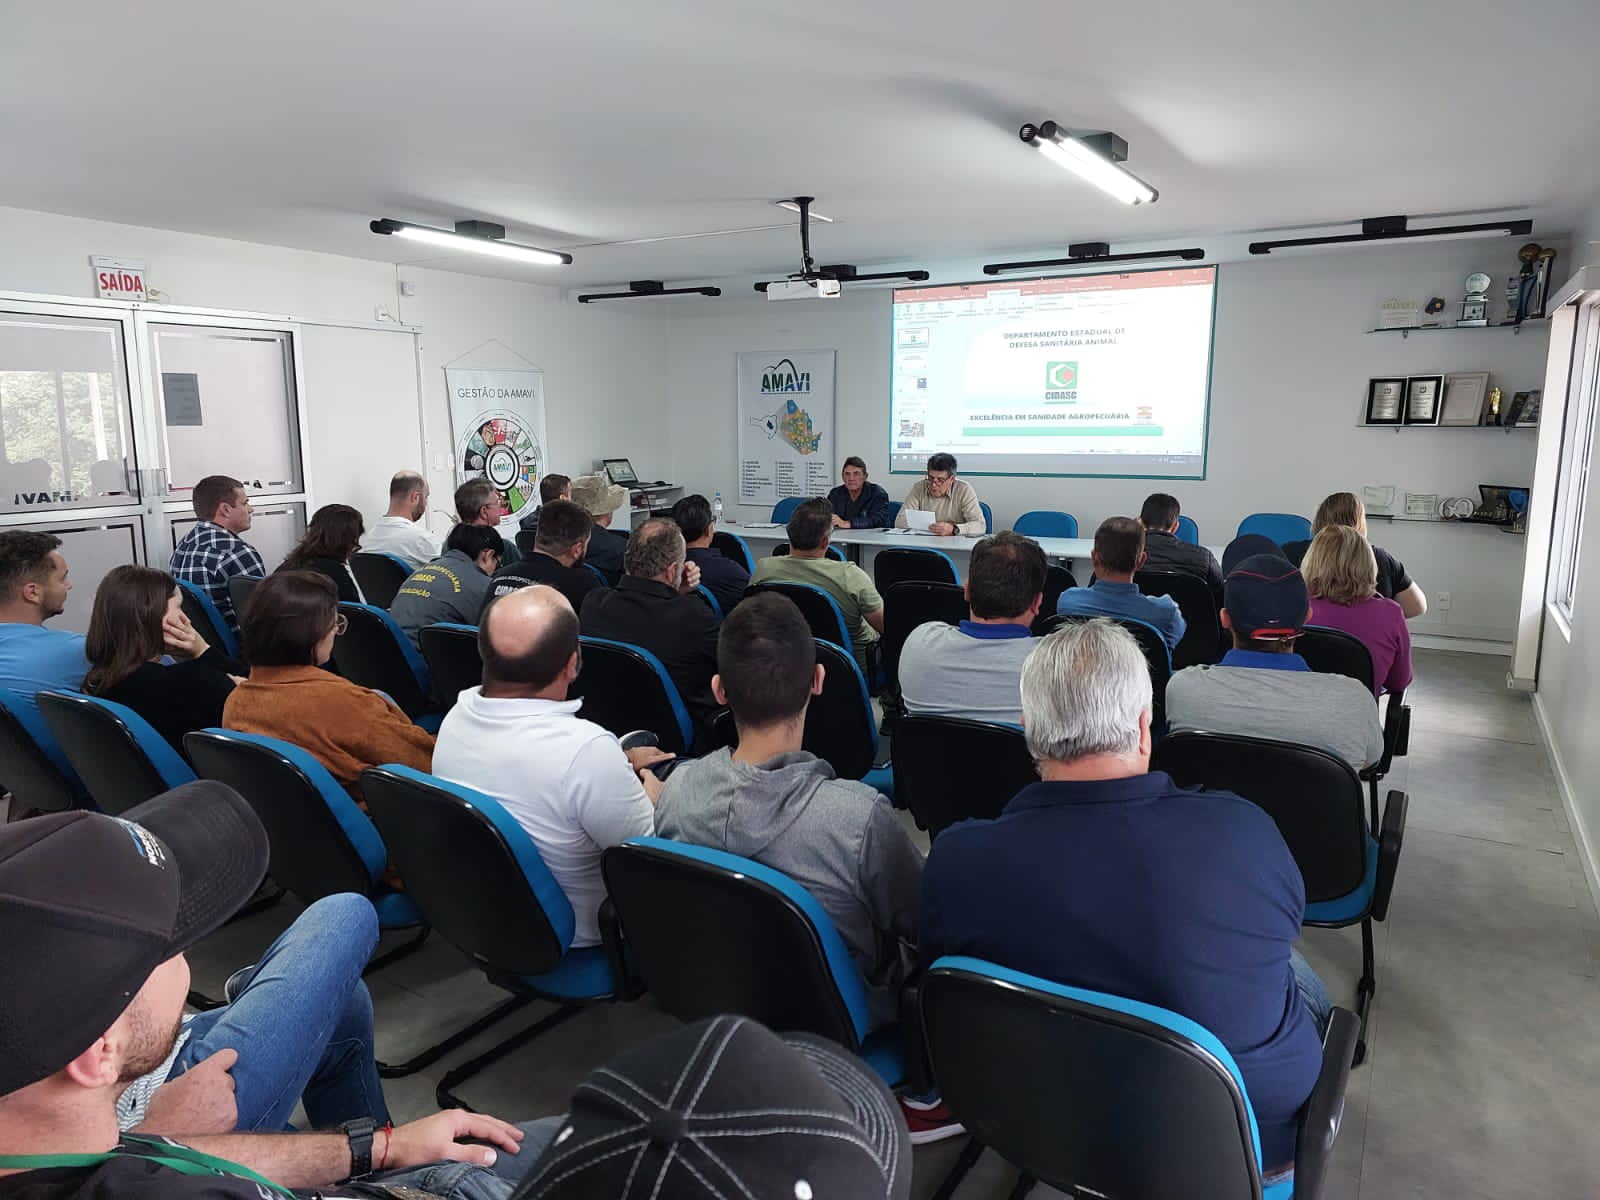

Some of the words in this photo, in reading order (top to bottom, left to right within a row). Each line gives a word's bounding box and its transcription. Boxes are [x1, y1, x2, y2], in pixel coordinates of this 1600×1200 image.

[99, 270, 144, 292] SAÍDA
[1003, 329, 1069, 339] DEPARTAMENTO
[1070, 328, 1111, 337] ESTADUAL
[1009, 341, 1038, 349] DEFESA
[1040, 338, 1082, 347] SANITÁRIA
[1085, 337, 1119, 345] ANIMAL
[761, 372, 810, 392] AMAVI
[457, 386, 496, 399] GESTÃO
[497, 387, 510, 399] DA
[510, 387, 535, 399] AMAVI
[1045, 391, 1077, 401] CIDASC
[970, 413, 1013, 421] EXCELÊNCIA
[1068, 411, 1130, 420] AGROPECUÁRIA
[493, 463, 512, 473] AMAVI
